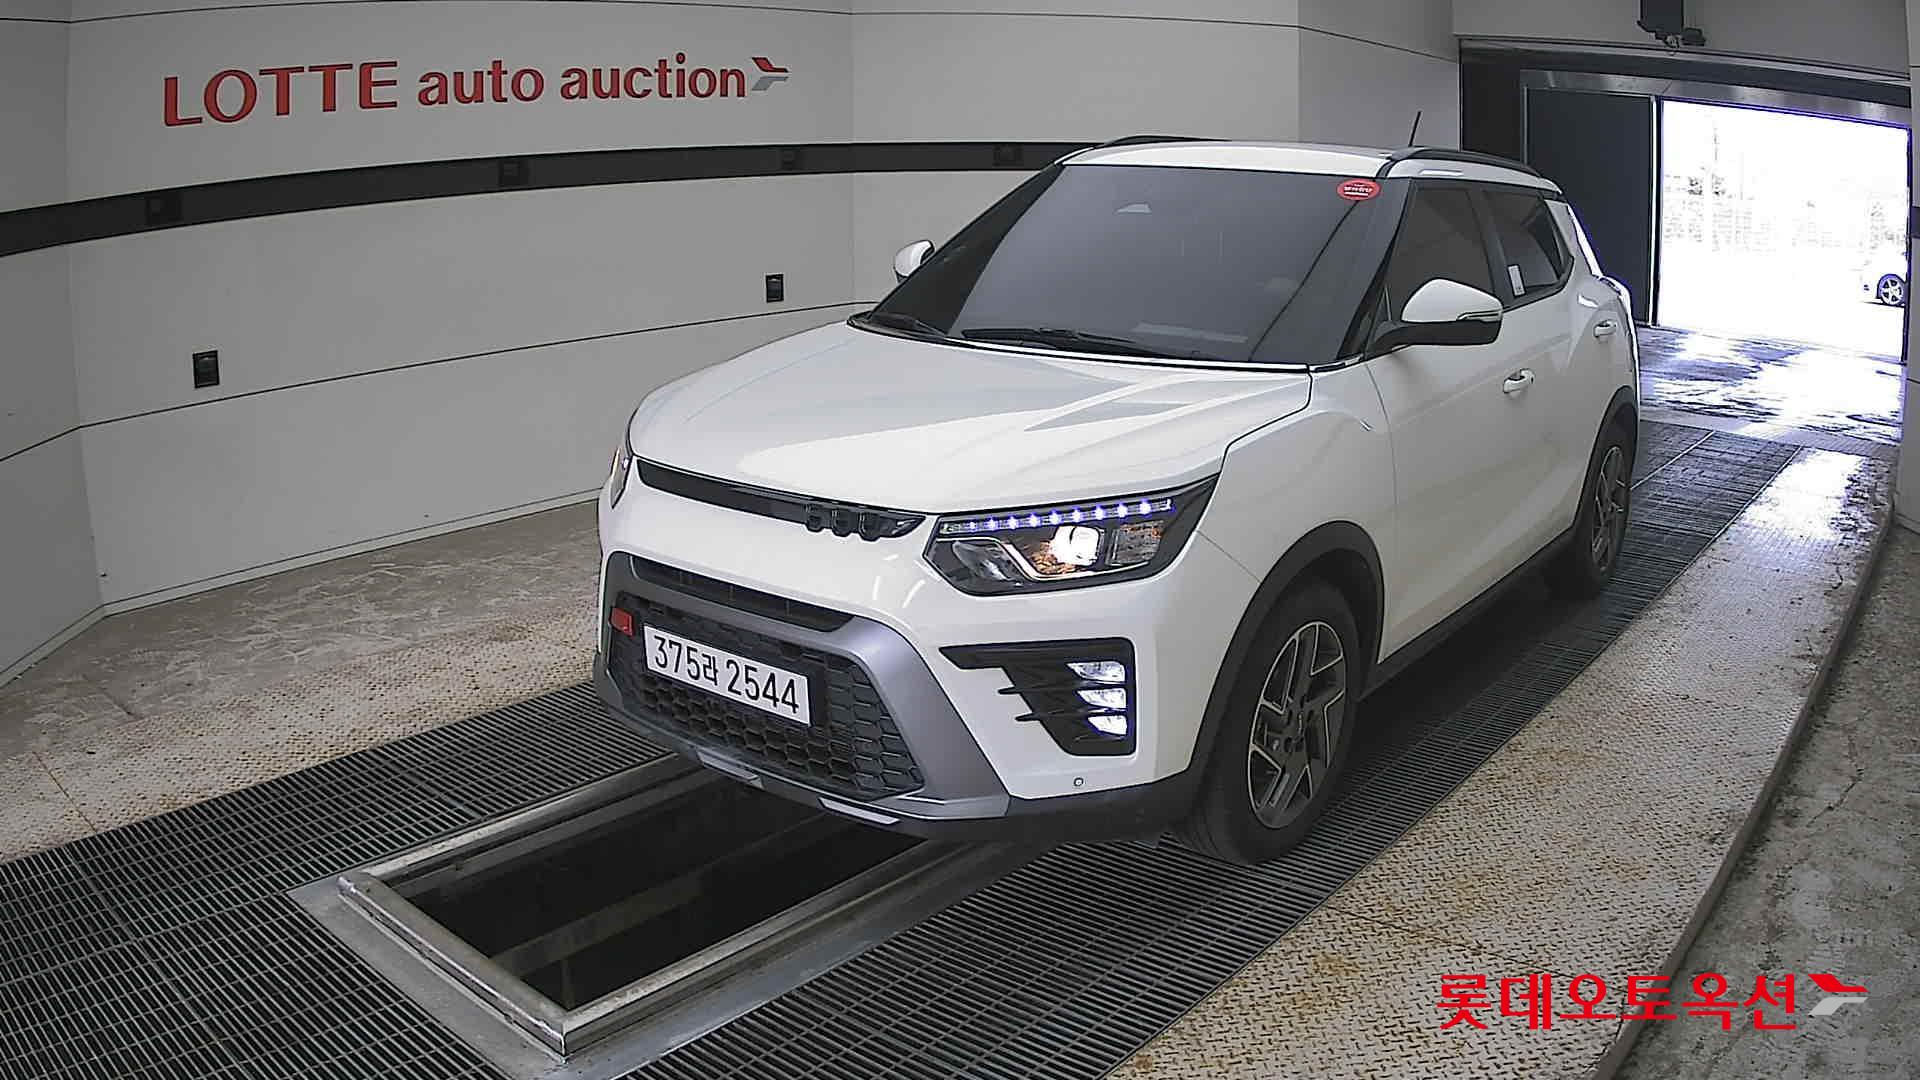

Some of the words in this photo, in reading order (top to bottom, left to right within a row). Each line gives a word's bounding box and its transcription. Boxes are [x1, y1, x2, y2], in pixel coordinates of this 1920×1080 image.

[163, 60, 398, 127] LOTTE
[417, 58, 545, 106] auto
[560, 52, 746, 101] auction
[725, 658, 800, 714] 2544
